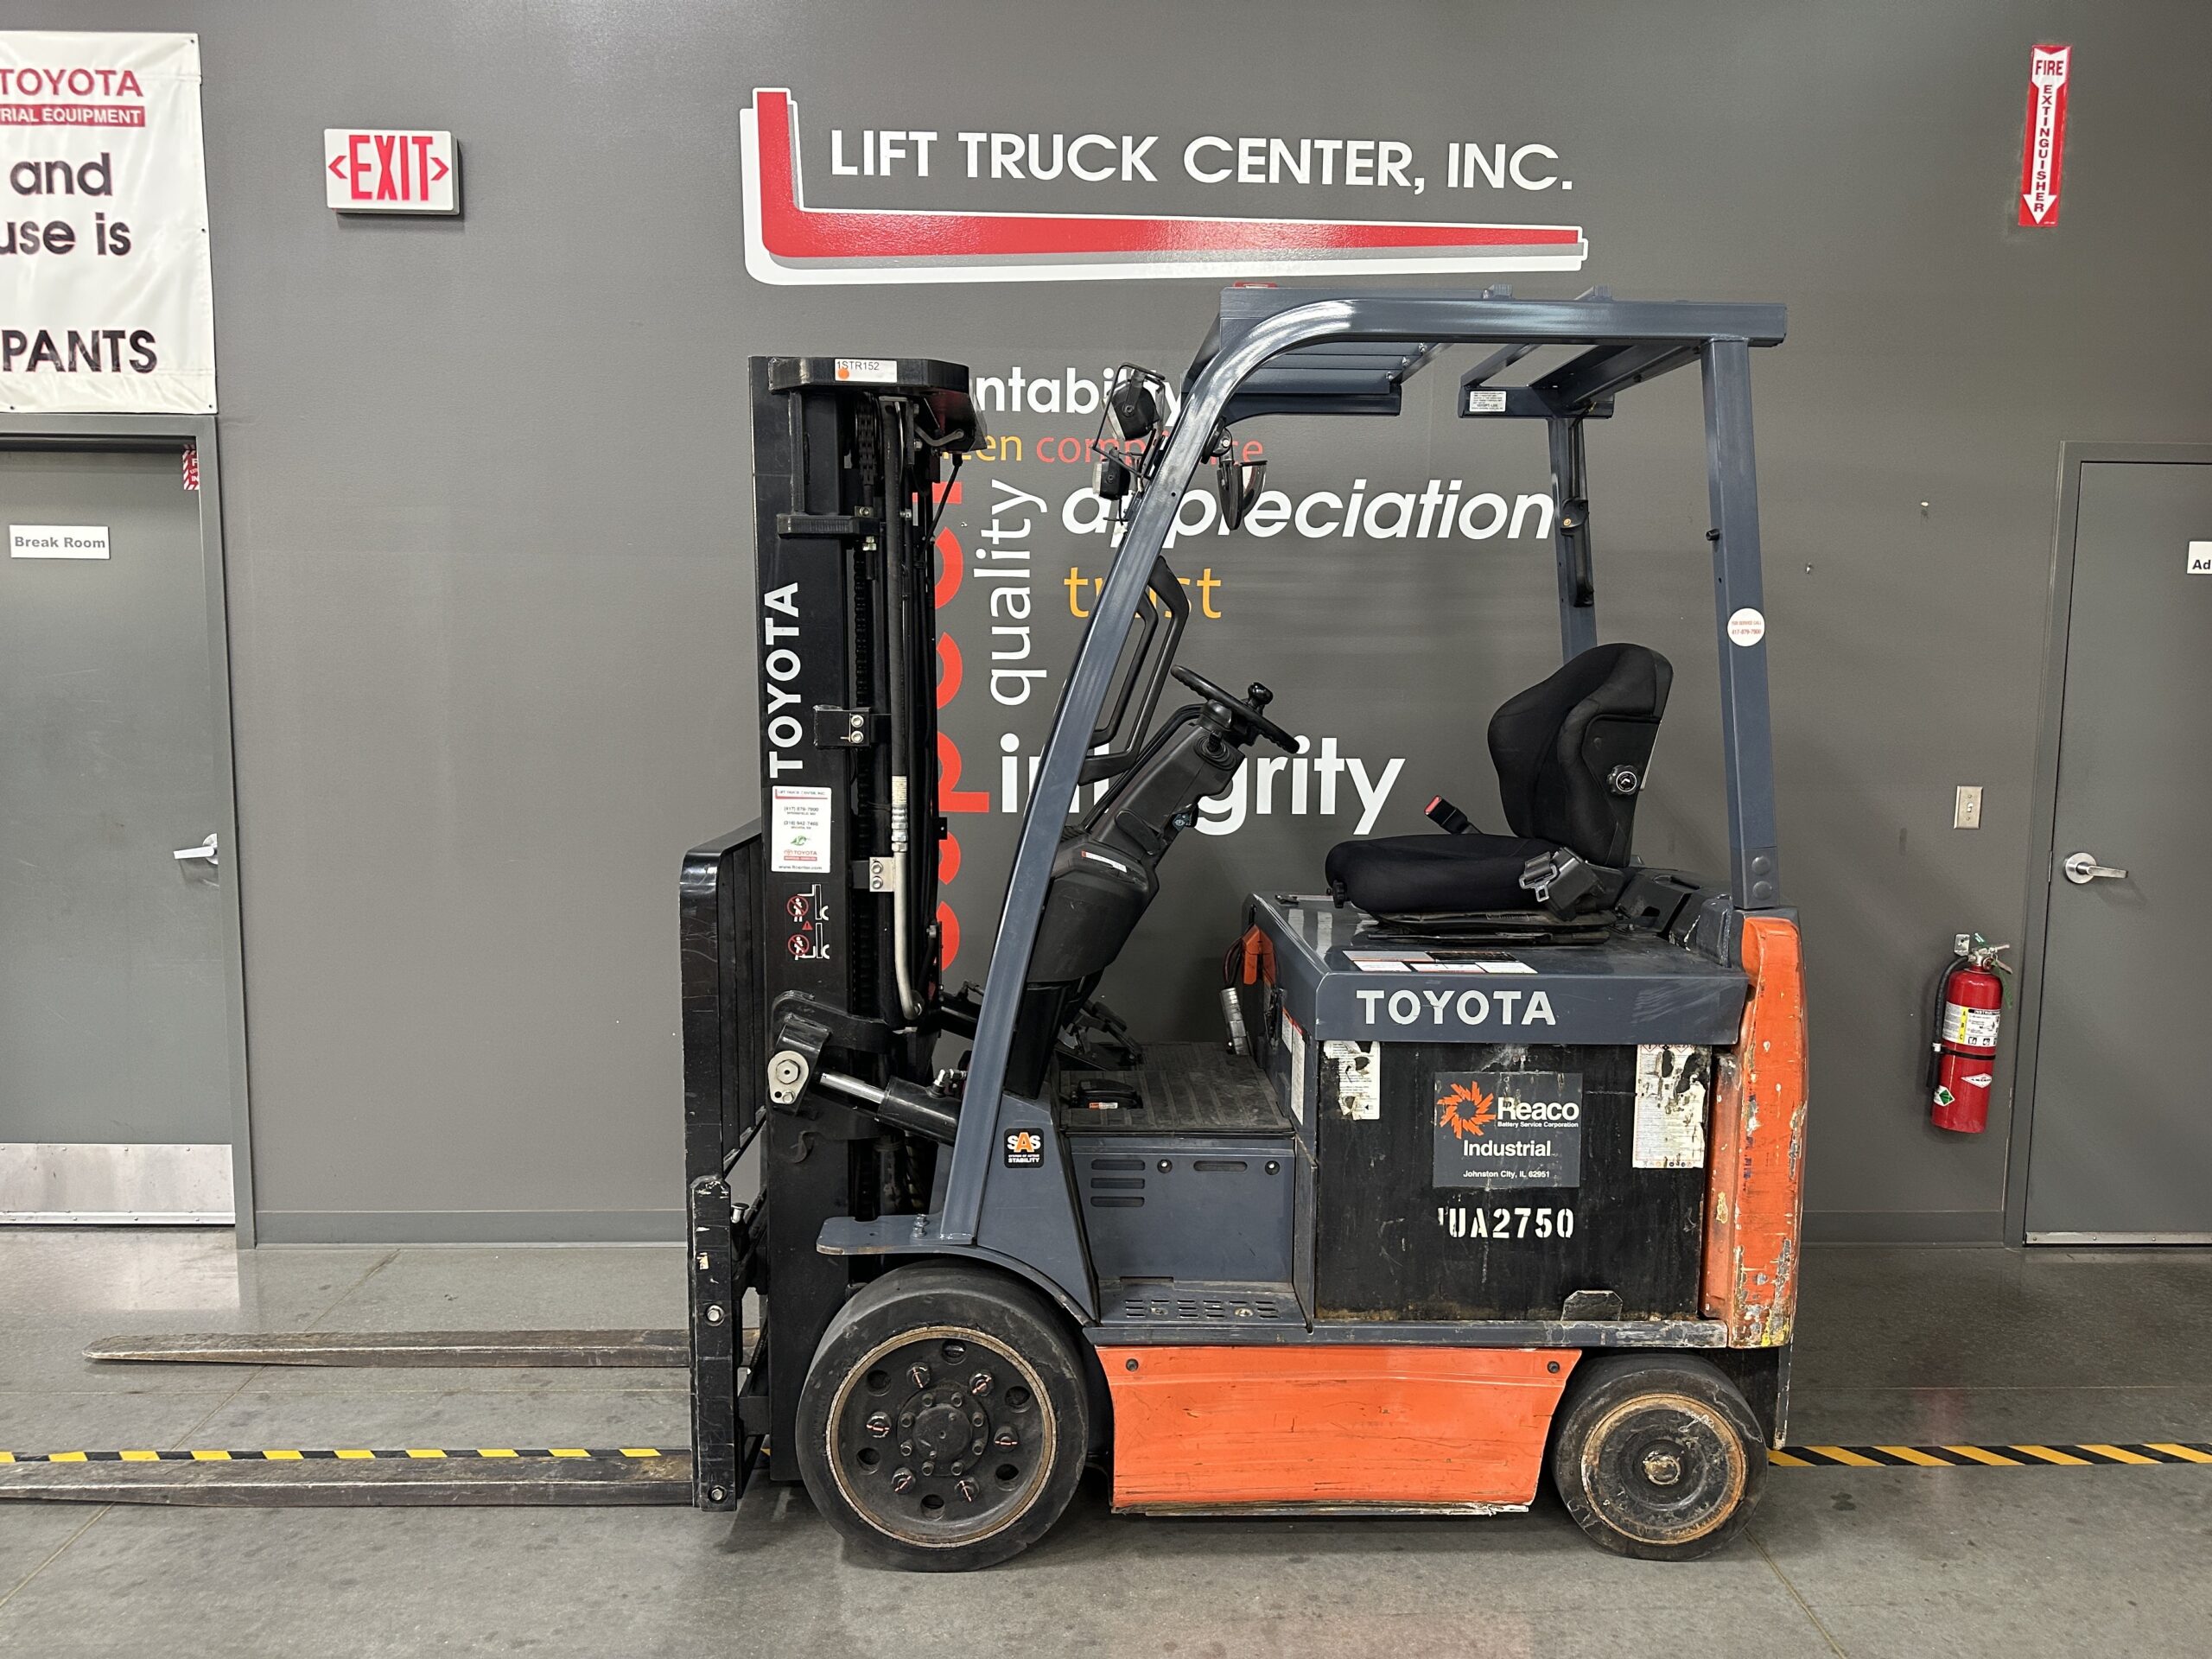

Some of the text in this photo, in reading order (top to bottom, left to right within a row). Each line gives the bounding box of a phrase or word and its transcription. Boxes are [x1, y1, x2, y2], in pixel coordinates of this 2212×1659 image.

[0, 68, 144, 97] TOYOTA
[2035, 60, 2064, 76] FIRE
[43, 108, 142, 124] EQUIPMENT
[831, 130, 1573, 195] LIFT TRUCK CENTER, INC.
[2033, 85, 2054, 213] EXTINGUISHER
[10, 152, 112, 197] and
[348, 135, 433, 201] EXIT
[95, 212, 132, 257] is
[2, 329, 158, 374] PANTS
[15, 536, 106, 550] Break Room
[2192, 559, 2212, 570] Ad
[974, 479, 1047, 706] quality
[764, 582, 804, 779] TOYOTA
[1356, 989, 1556, 1026] TOYOTA
[1497, 1096, 1580, 1121] Reaco
[1007, 1132, 1042, 1153] SAS
[1464, 1140, 1551, 1157] Industrial
[1500, 1170, 1517, 1179] City,
